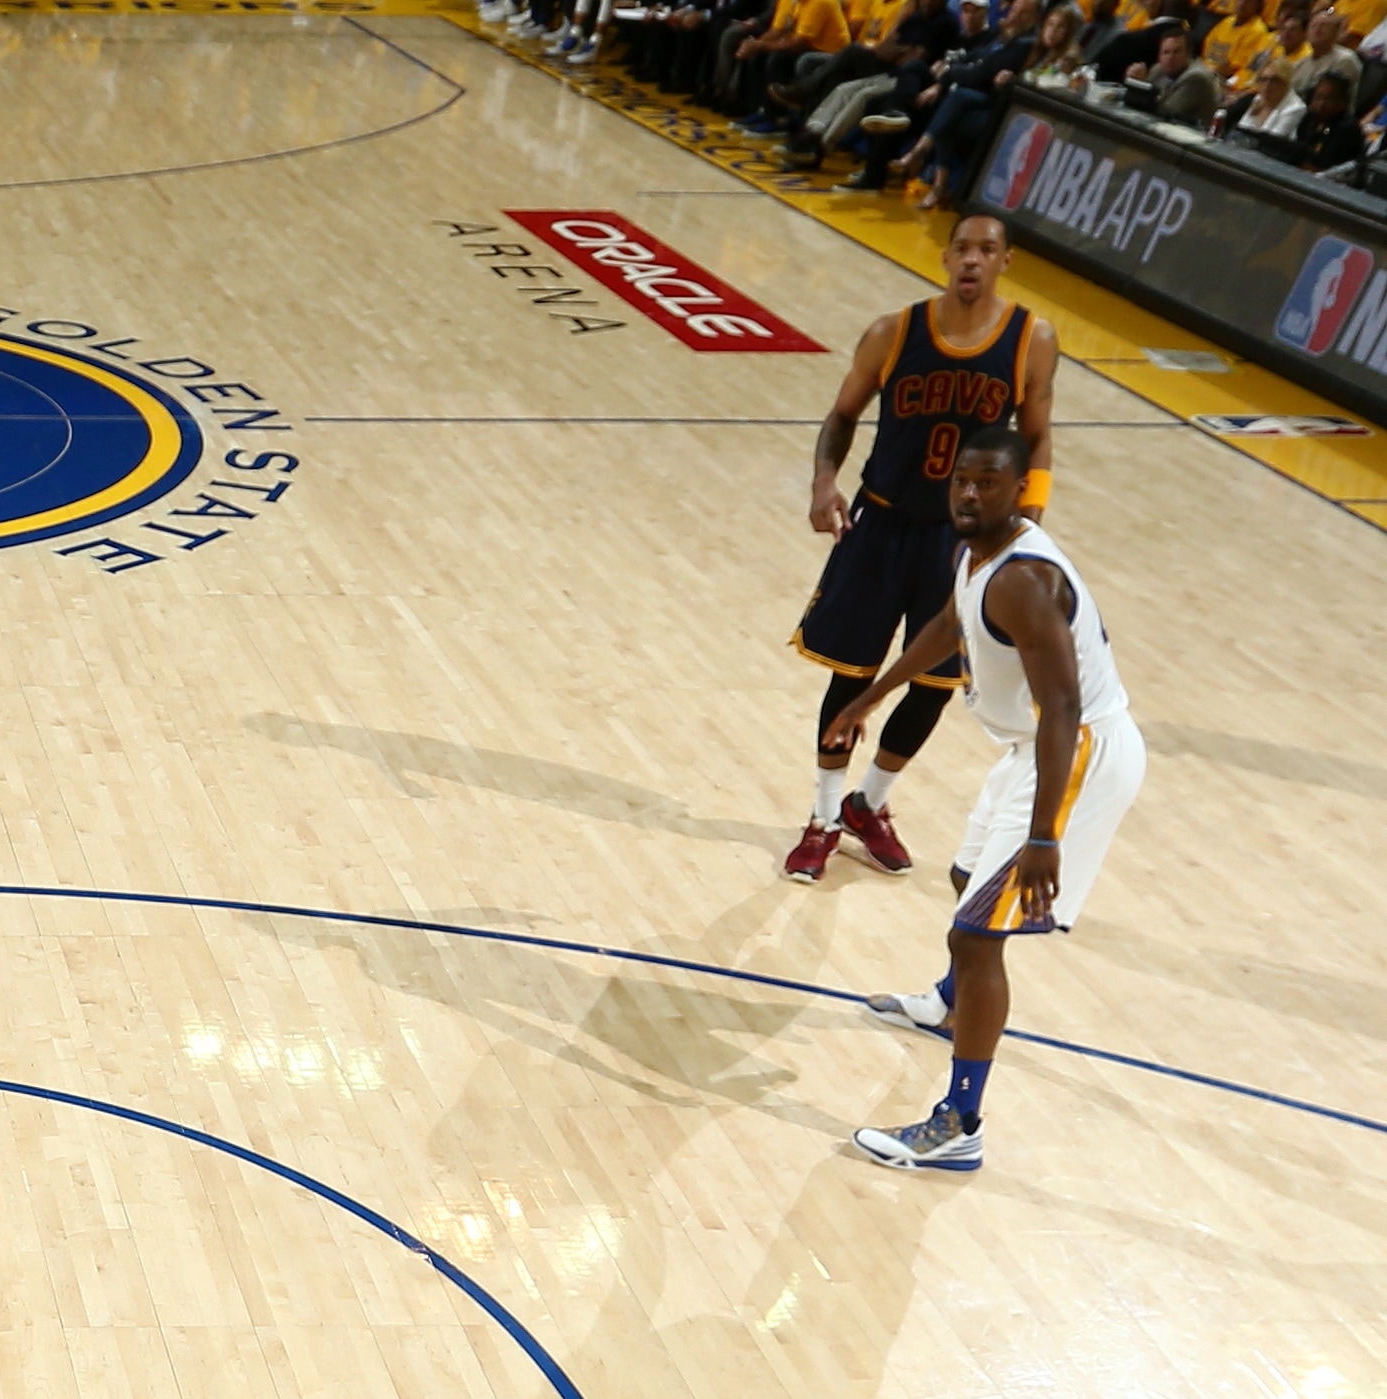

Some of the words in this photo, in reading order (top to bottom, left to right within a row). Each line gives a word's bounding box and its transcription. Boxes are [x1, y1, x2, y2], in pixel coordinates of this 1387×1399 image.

[1027, 137, 1115, 235] NBA
[1094, 170, 1194, 263] APP
[432, 220, 628, 335] ARENA
[550, 219, 774, 338] ORACLE
[893, 369, 1010, 424] CAVS
[923, 422, 960, 479] 9
[53, 448, 300, 575] STATE
